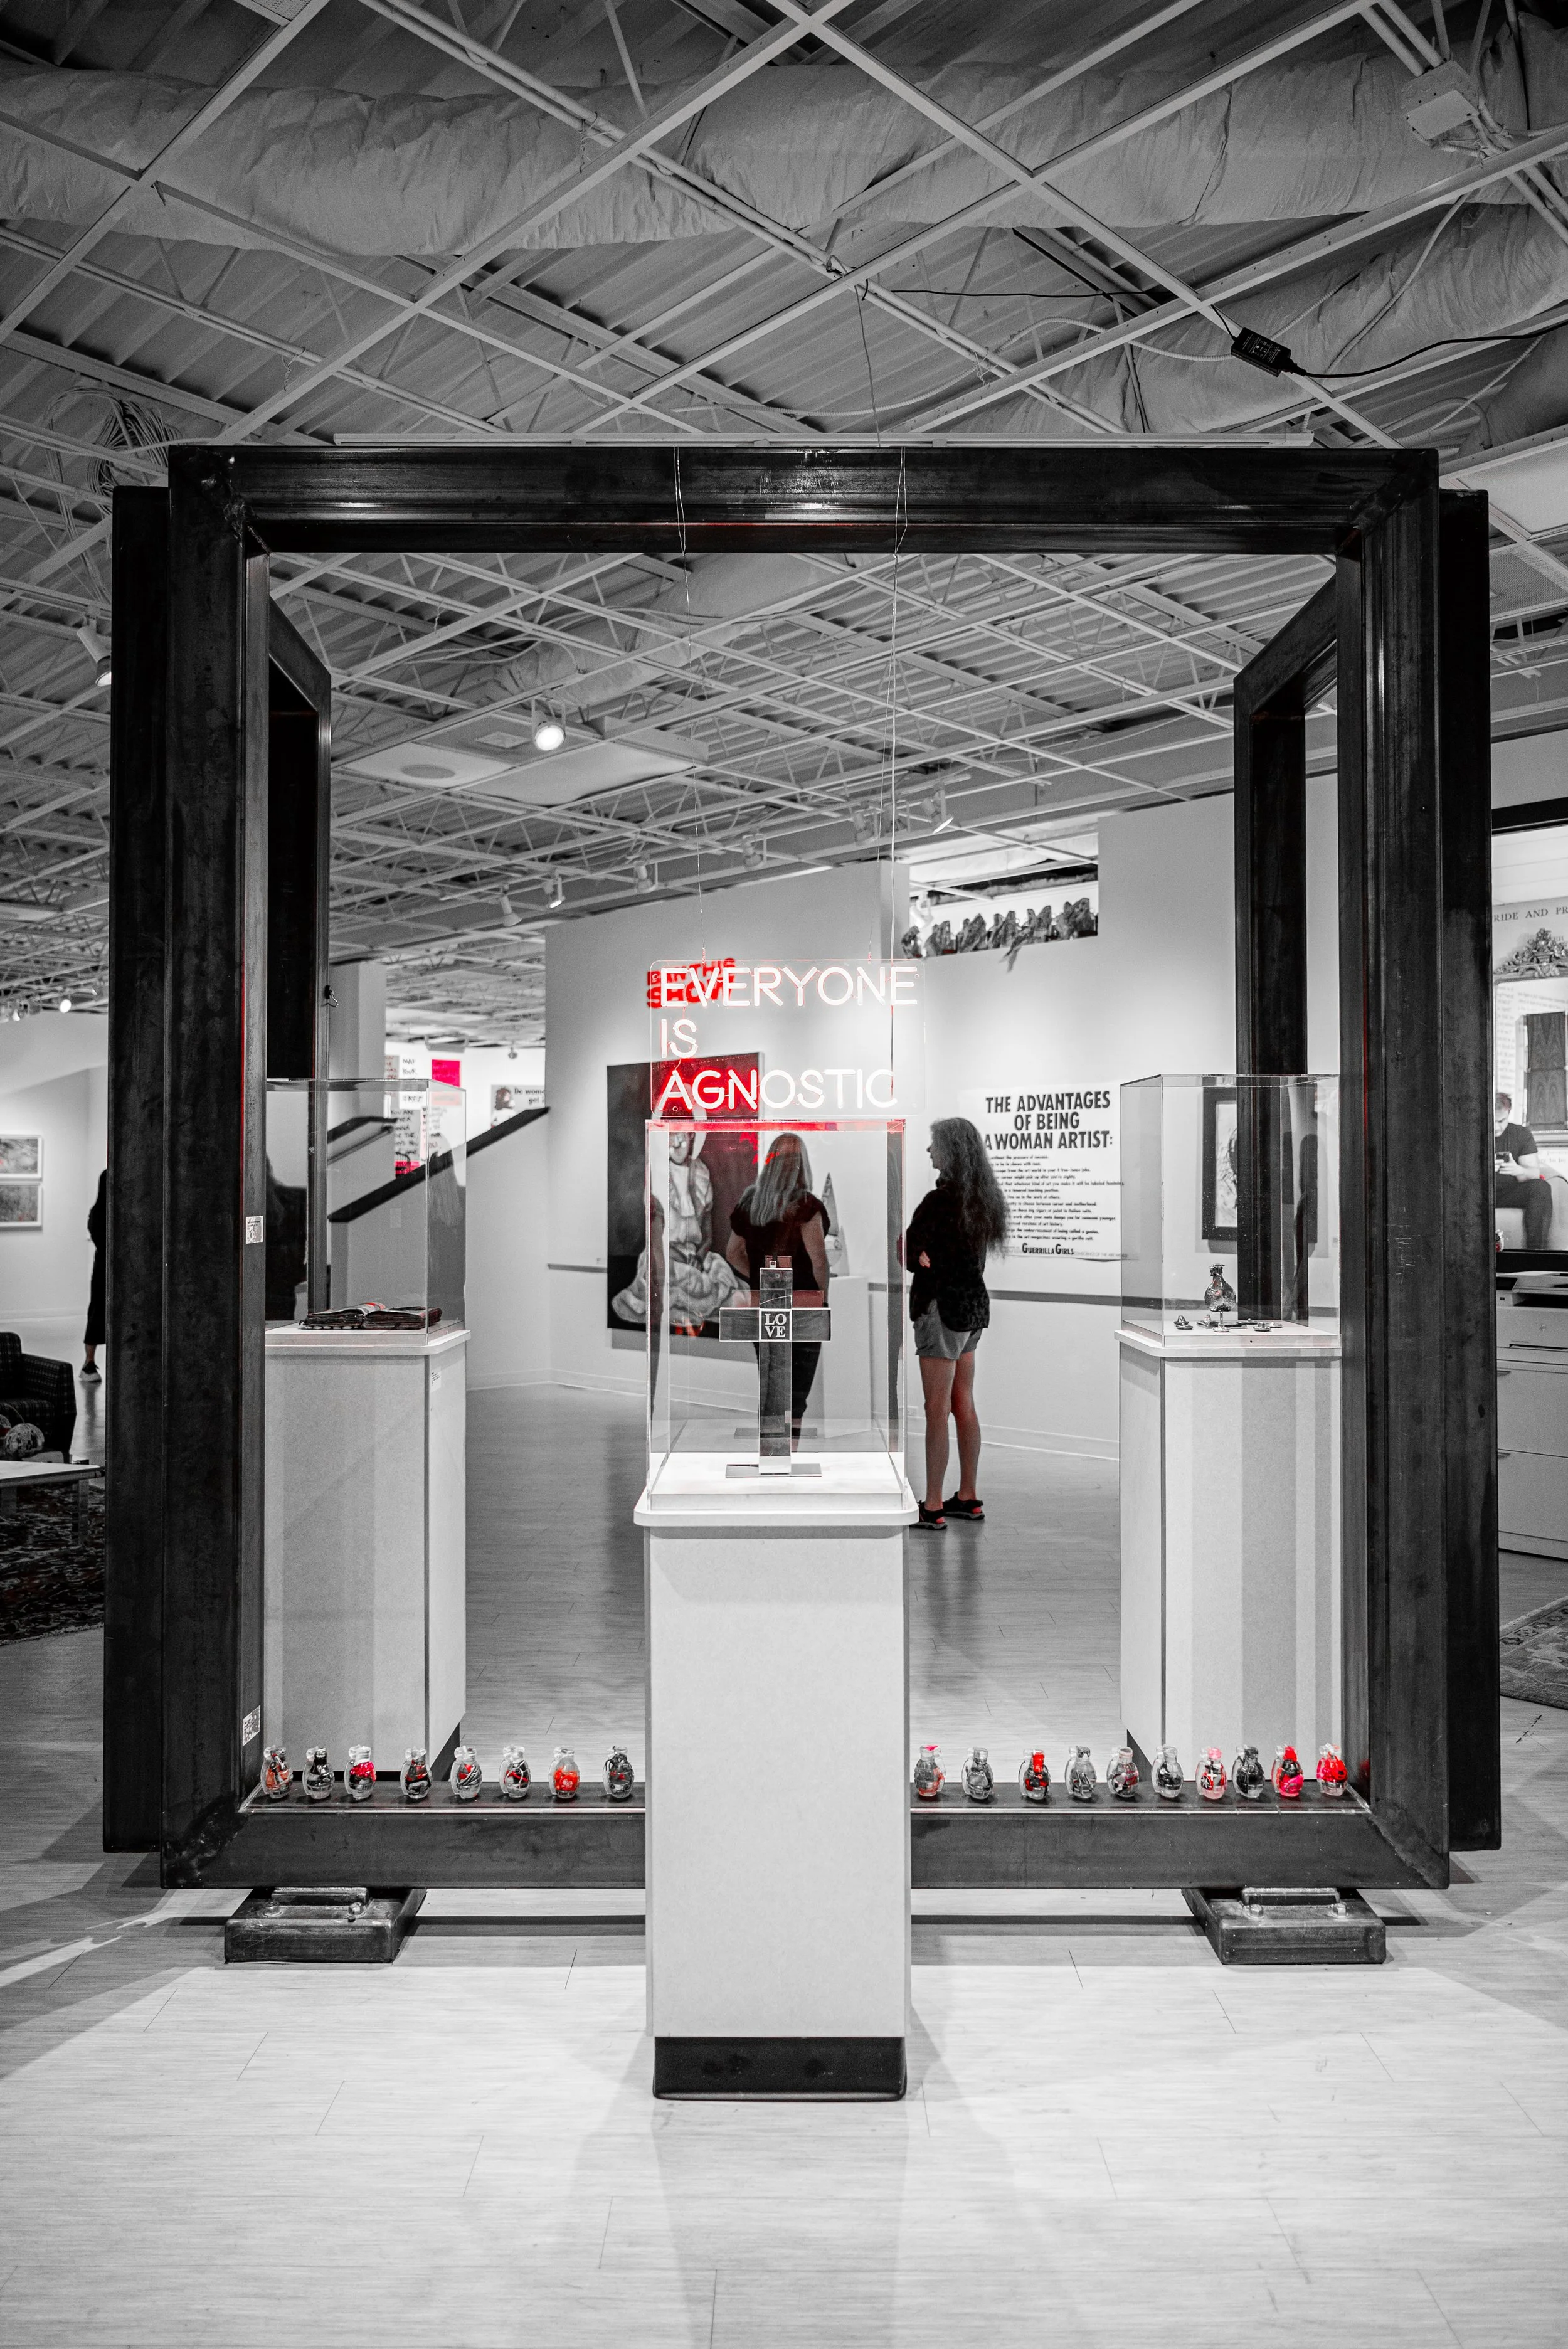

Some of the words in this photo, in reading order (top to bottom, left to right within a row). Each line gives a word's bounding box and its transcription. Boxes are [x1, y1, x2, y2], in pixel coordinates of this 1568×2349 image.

[1493, 912, 1518, 922] RIDE
[1525, 908, 1549, 918] AND
[660, 966, 918, 1007] EVERYONE
[660, 1019, 698, 1058] IS
[658, 1069, 898, 1111] AGNOSTIC
[985, 1096, 1012, 1113] THE
[1017, 1091, 1110, 1112] ADVANTAGES
[1014, 1114, 1032, 1131] OF
[1037, 1111, 1079, 1130] BEING
[985, 1134, 992, 1150] A
[994, 1132, 1053, 1150] WOMAN
[1057, 1130, 1113, 1149] ARTIST:
[1022, 1243, 1054, 1254] GUERRILLA
[1056, 1243, 1074, 1255] GIRLS
[765, 1313, 787, 1325] LO
[765, 1326, 785, 1337] VE
